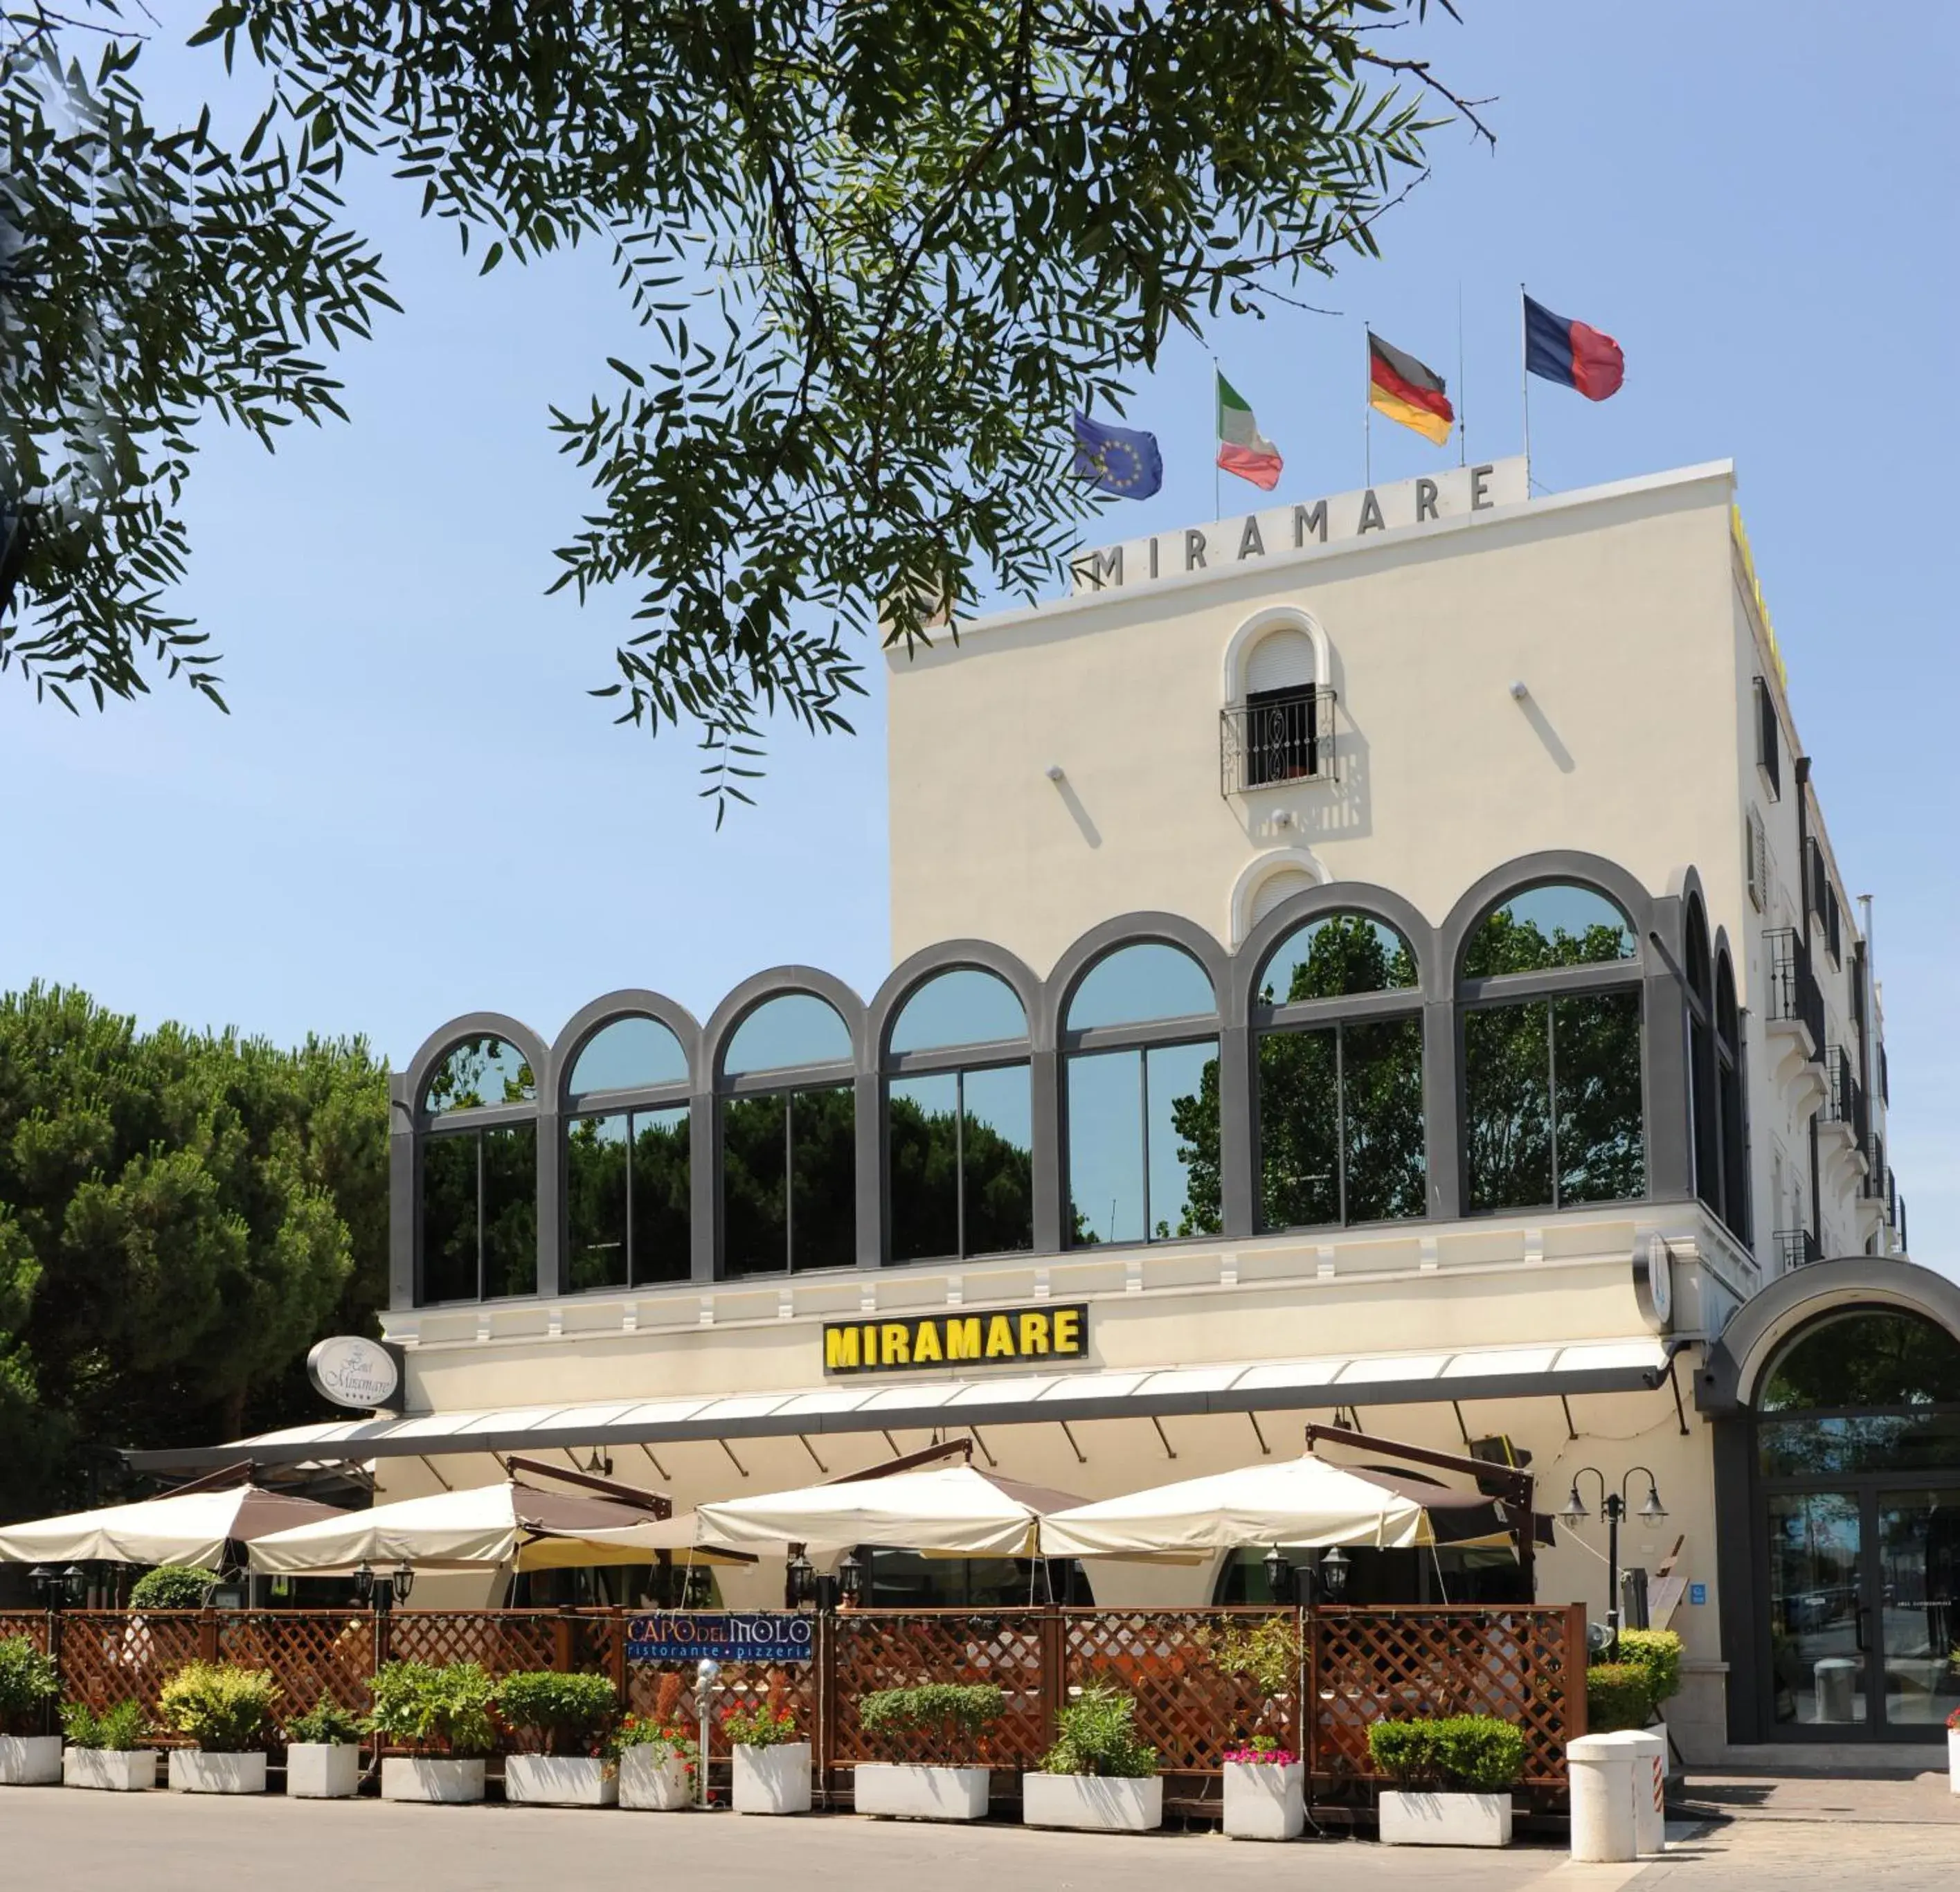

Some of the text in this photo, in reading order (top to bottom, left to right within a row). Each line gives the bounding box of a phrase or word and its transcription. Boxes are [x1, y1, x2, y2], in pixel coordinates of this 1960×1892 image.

[1092, 464, 1495, 592] MIRAMARE
[826, 1310, 1079, 1368] MIRAMARE
[627, 1618, 811, 1643] CAPO DEL MOLO
[628, 1644, 811, 1659] ristorante pizzeria
